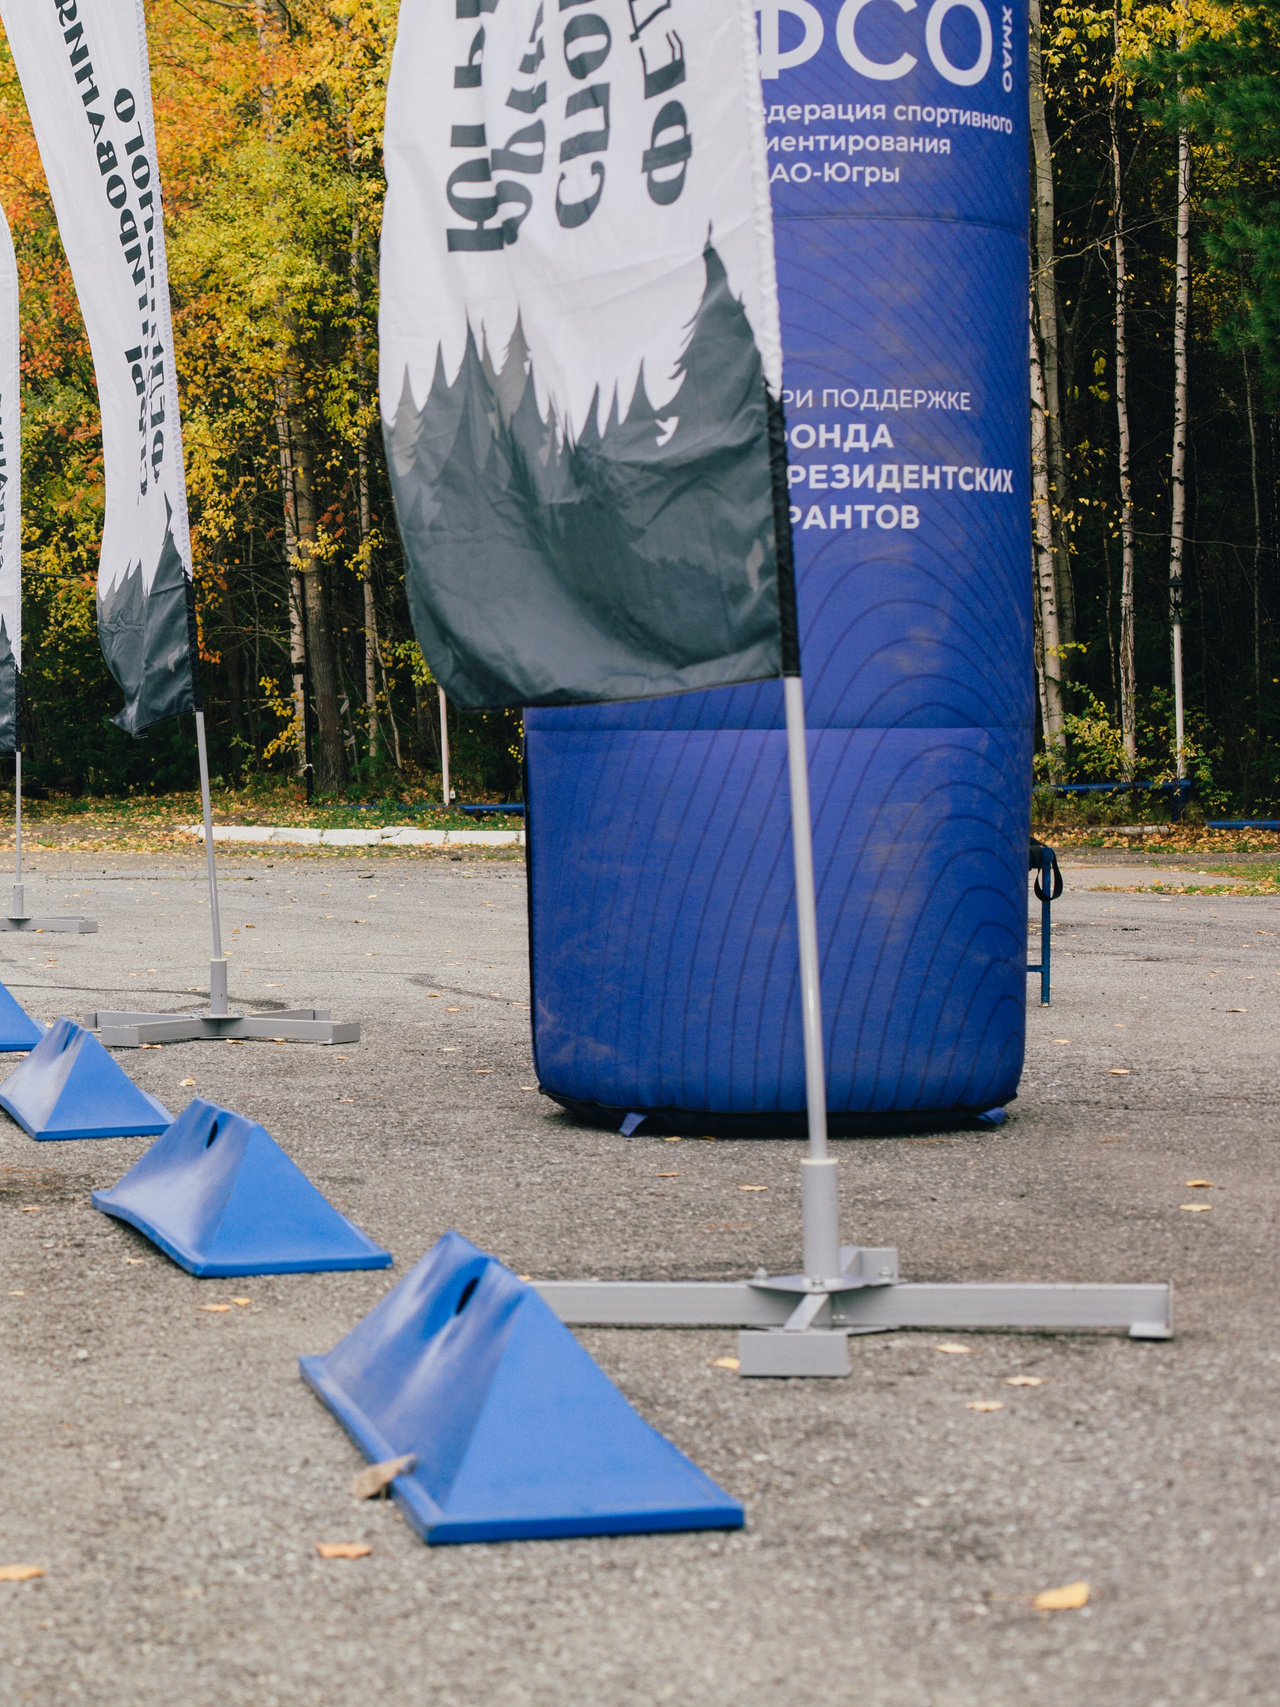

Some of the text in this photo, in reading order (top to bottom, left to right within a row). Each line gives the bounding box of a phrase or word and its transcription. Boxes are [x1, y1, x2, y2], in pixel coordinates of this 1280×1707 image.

[1001, 5, 1013, 93] ХМАО
[893, 104, 1013, 135] спортивного
[770, 161, 900, 187] АО-Югры
[822, 388, 971, 411] ПОДДЕРЖКЕ
[783, 423, 894, 453] ОНДА
